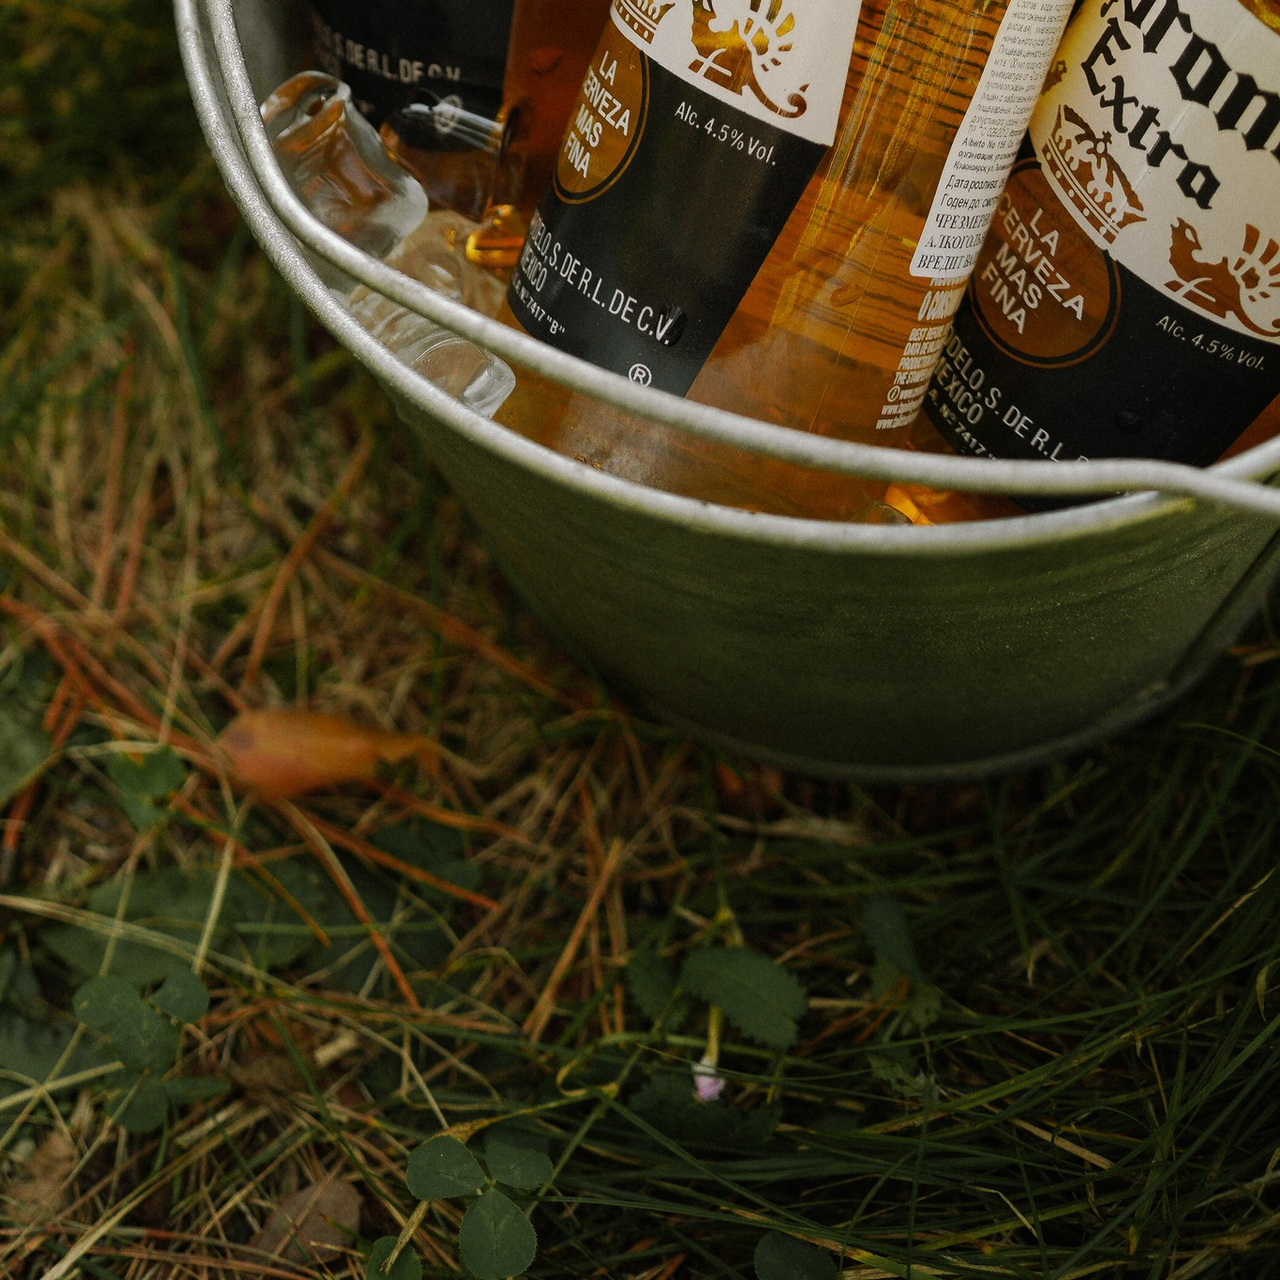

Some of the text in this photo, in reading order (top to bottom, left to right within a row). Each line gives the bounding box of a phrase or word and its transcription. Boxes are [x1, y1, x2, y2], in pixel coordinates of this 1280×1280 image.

[599, 50, 618, 86] LA
[575, 103, 603, 148] MAS
[674, 101, 777, 166] Alc. 4.5% Vol.
[1080, 16, 1221, 211] Extra
[563, 130, 591, 179] FINA
[939, 193, 968, 210] Годен
[945, 174, 969, 191] Дата
[998, 191, 1085, 321] CERVEZA
[1029, 207, 1060, 258] LA
[548, 241, 562, 271] S.
[560, 251, 581, 286] DE
[577, 267, 605, 308] R.L.
[608, 288, 638, 324] DE
[636, 305, 673, 346] C.V.
[980, 261, 1027, 335] FINA
[995, 242, 1043, 310] MAS
[526, 295, 546, 322] 7417
[1155, 315, 1265, 371] Alc. 4.5% Vol.
[984, 385, 1002, 415] S.
[1001, 404, 1034, 439] DE
[955, 421, 988, 456] 7417
